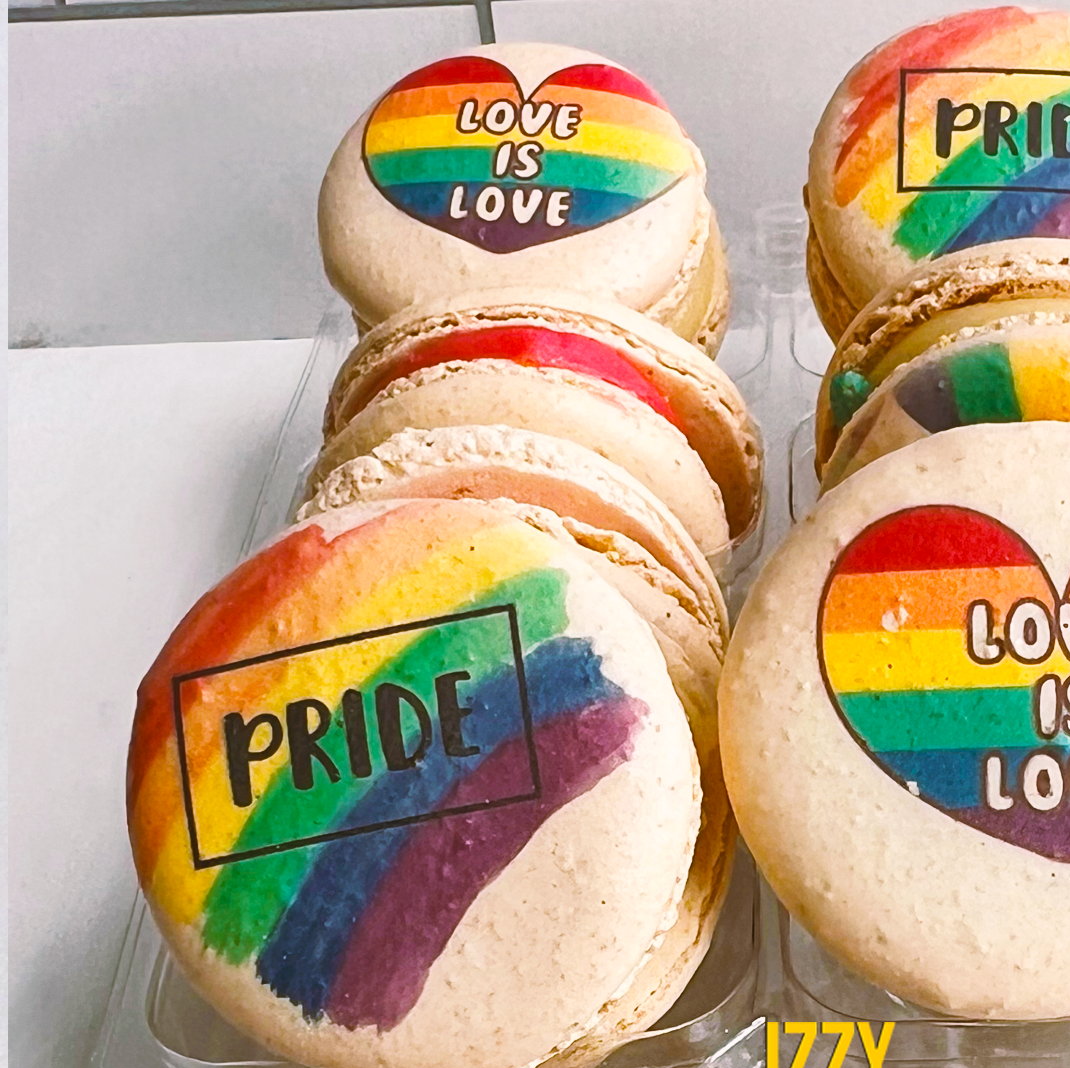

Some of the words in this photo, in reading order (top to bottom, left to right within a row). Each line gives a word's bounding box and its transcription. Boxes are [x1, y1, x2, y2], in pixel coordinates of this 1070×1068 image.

[456, 98, 583, 139] LOVE
[493, 140, 544, 180] IS
[448, 185, 572, 227] LOVE
[223, 670, 480, 807] PRIDE
